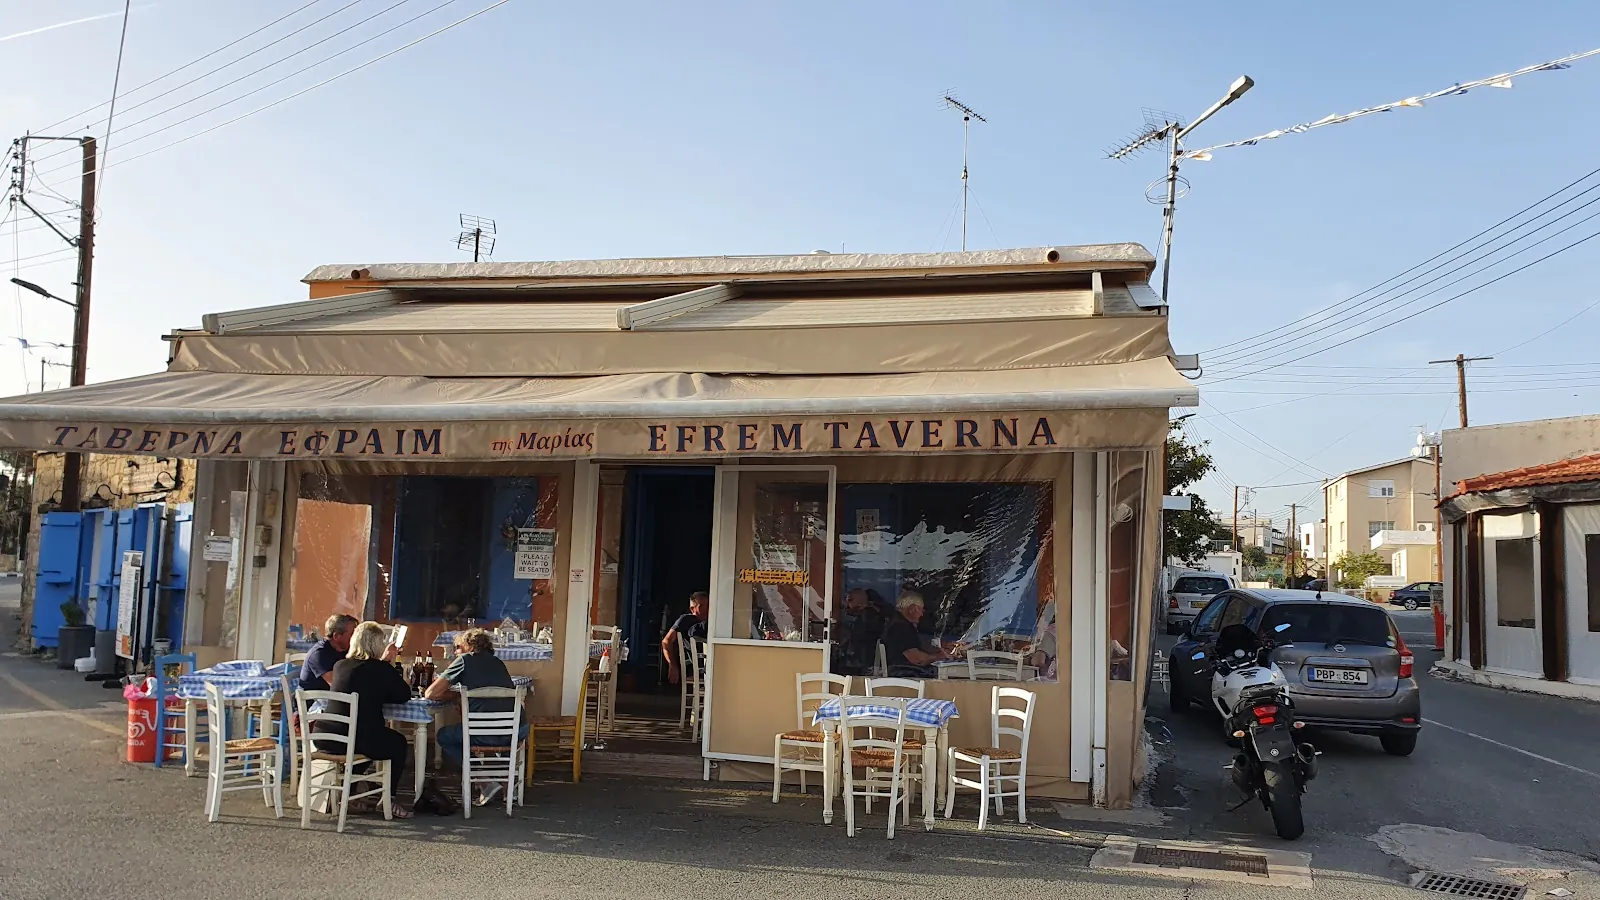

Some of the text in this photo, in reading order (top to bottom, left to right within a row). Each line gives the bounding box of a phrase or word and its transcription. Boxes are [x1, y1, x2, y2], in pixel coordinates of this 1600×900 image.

[52, 425, 443, 455] ΤΑΒΕΡΝΑ ΕΦΡΑΙΜ
[491, 427, 595, 454] της Μαρίας
[647, 416, 1058, 453] EFREM TAVERNA
[1316, 669, 1361, 681] PBP 854
